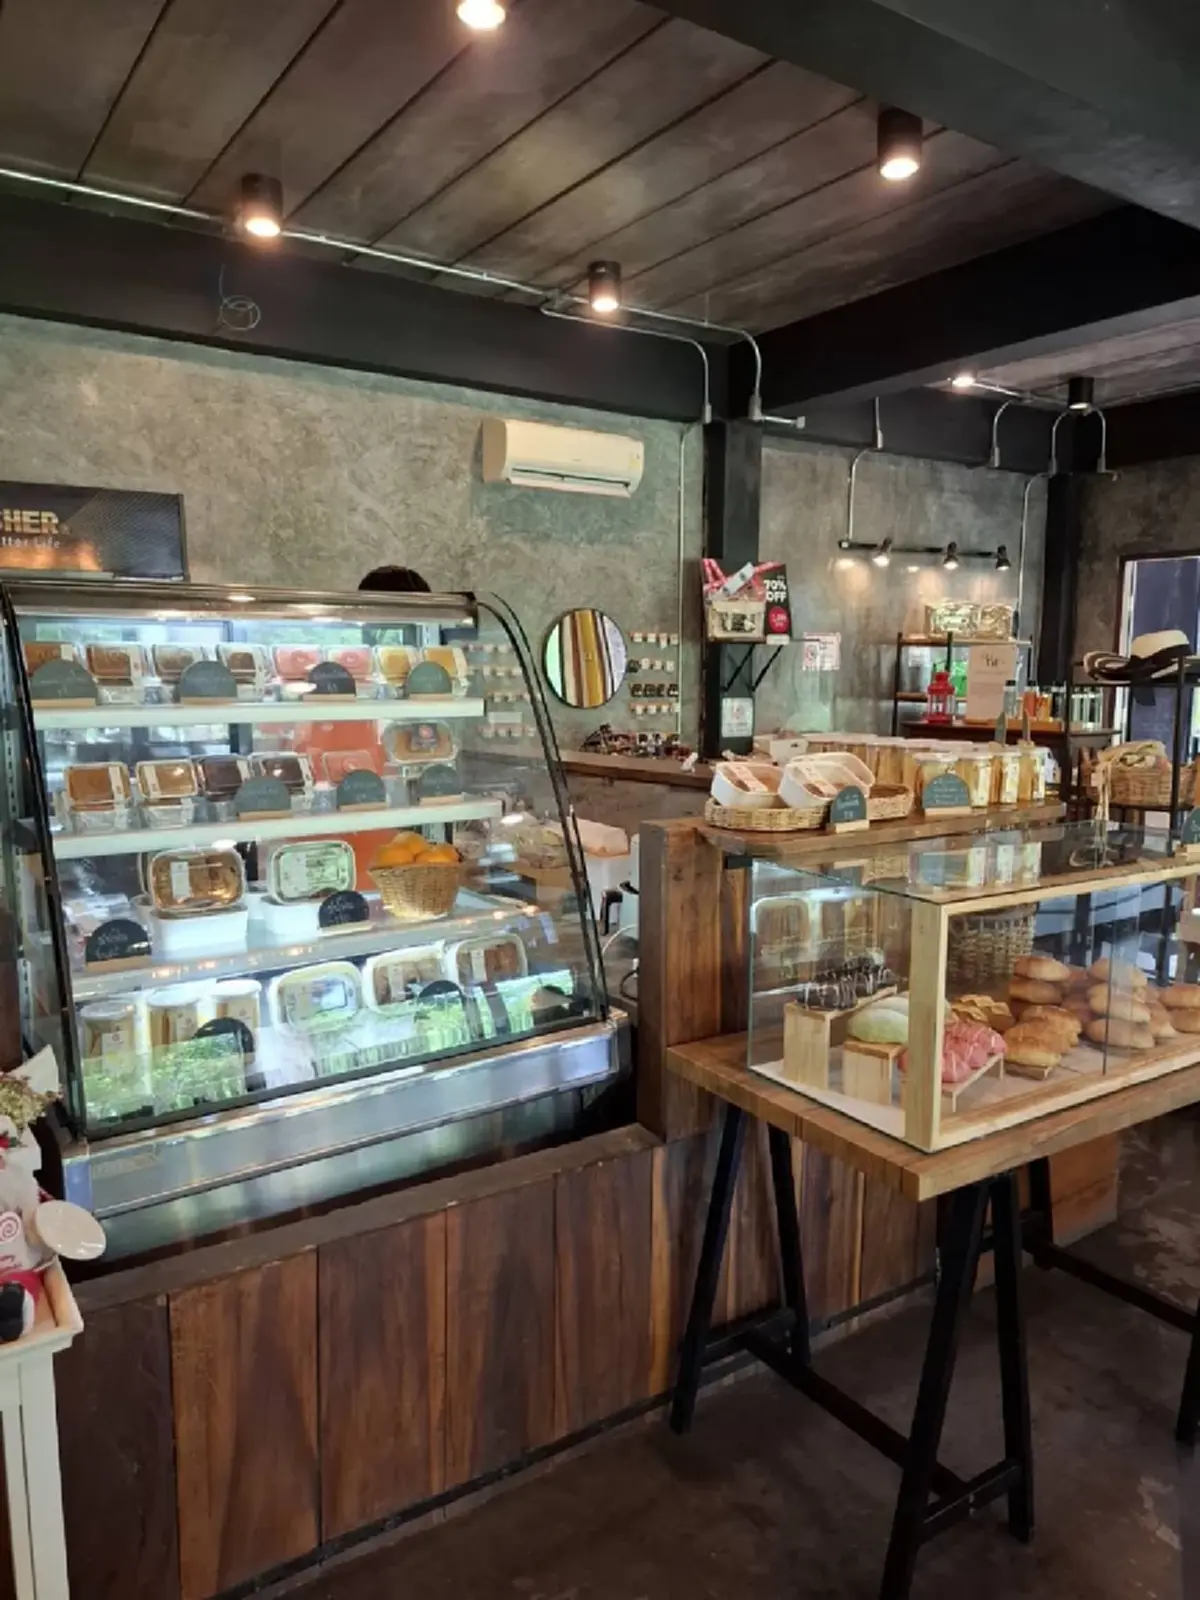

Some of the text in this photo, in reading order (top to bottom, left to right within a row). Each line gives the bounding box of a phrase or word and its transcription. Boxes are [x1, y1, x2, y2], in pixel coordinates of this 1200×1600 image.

[0, 509, 60, 534] HER
[763, 579, 787, 591] 70%
[766, 591, 787, 603] OFF
